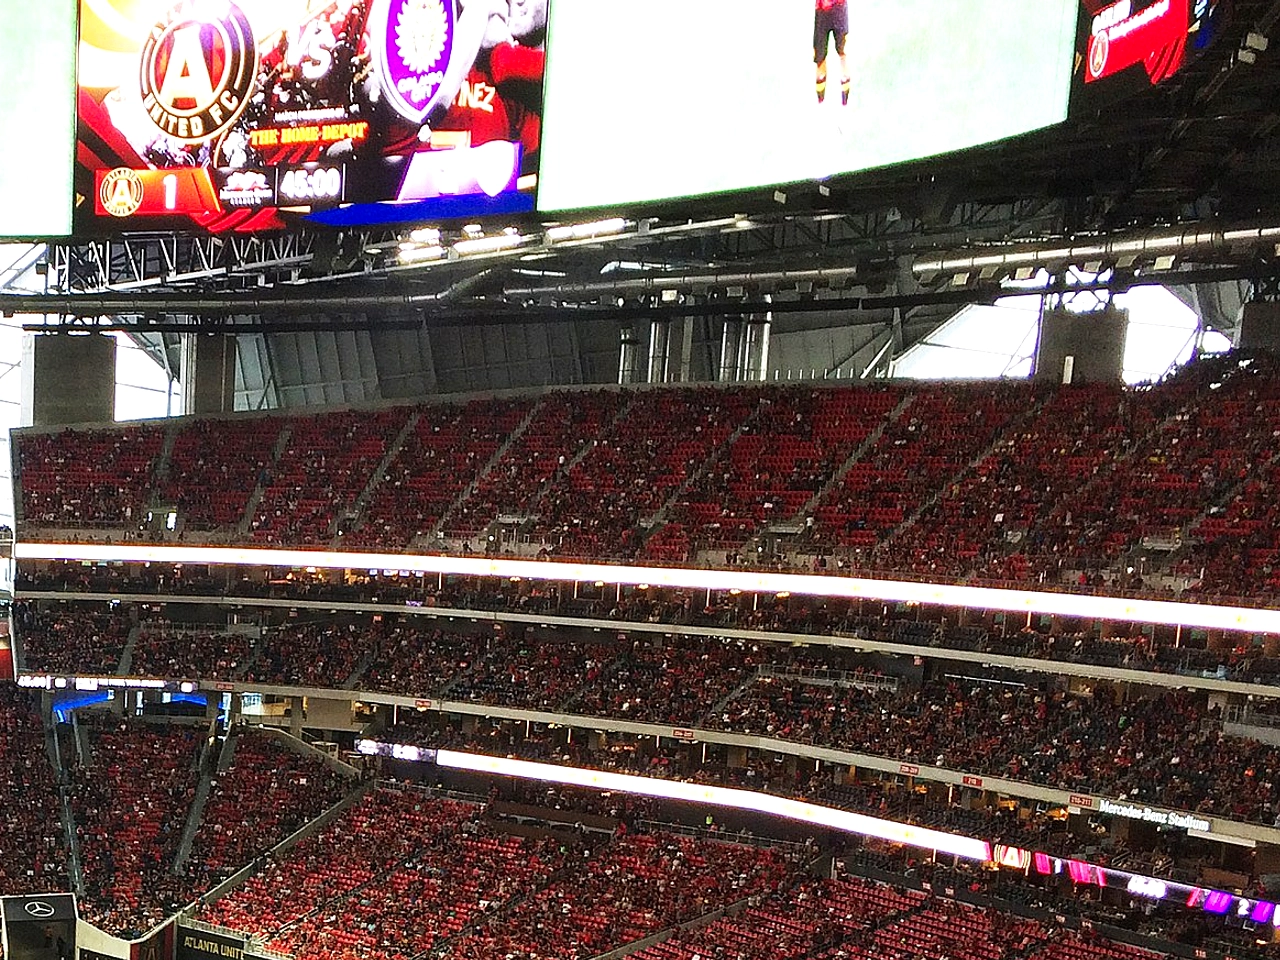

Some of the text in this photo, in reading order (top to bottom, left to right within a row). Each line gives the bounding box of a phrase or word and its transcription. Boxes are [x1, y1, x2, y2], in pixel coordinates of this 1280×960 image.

[143, 89, 239, 138] UNITED FC
[250, 121, 369, 146] THE HOME DEPOT
[162, 174, 177, 210] 1
[280, 167, 341, 199] 45:00
[1099, 799, 1210, 832] Mercedes-Benz Stadium
[184, 936, 219, 955] ATLANTA
